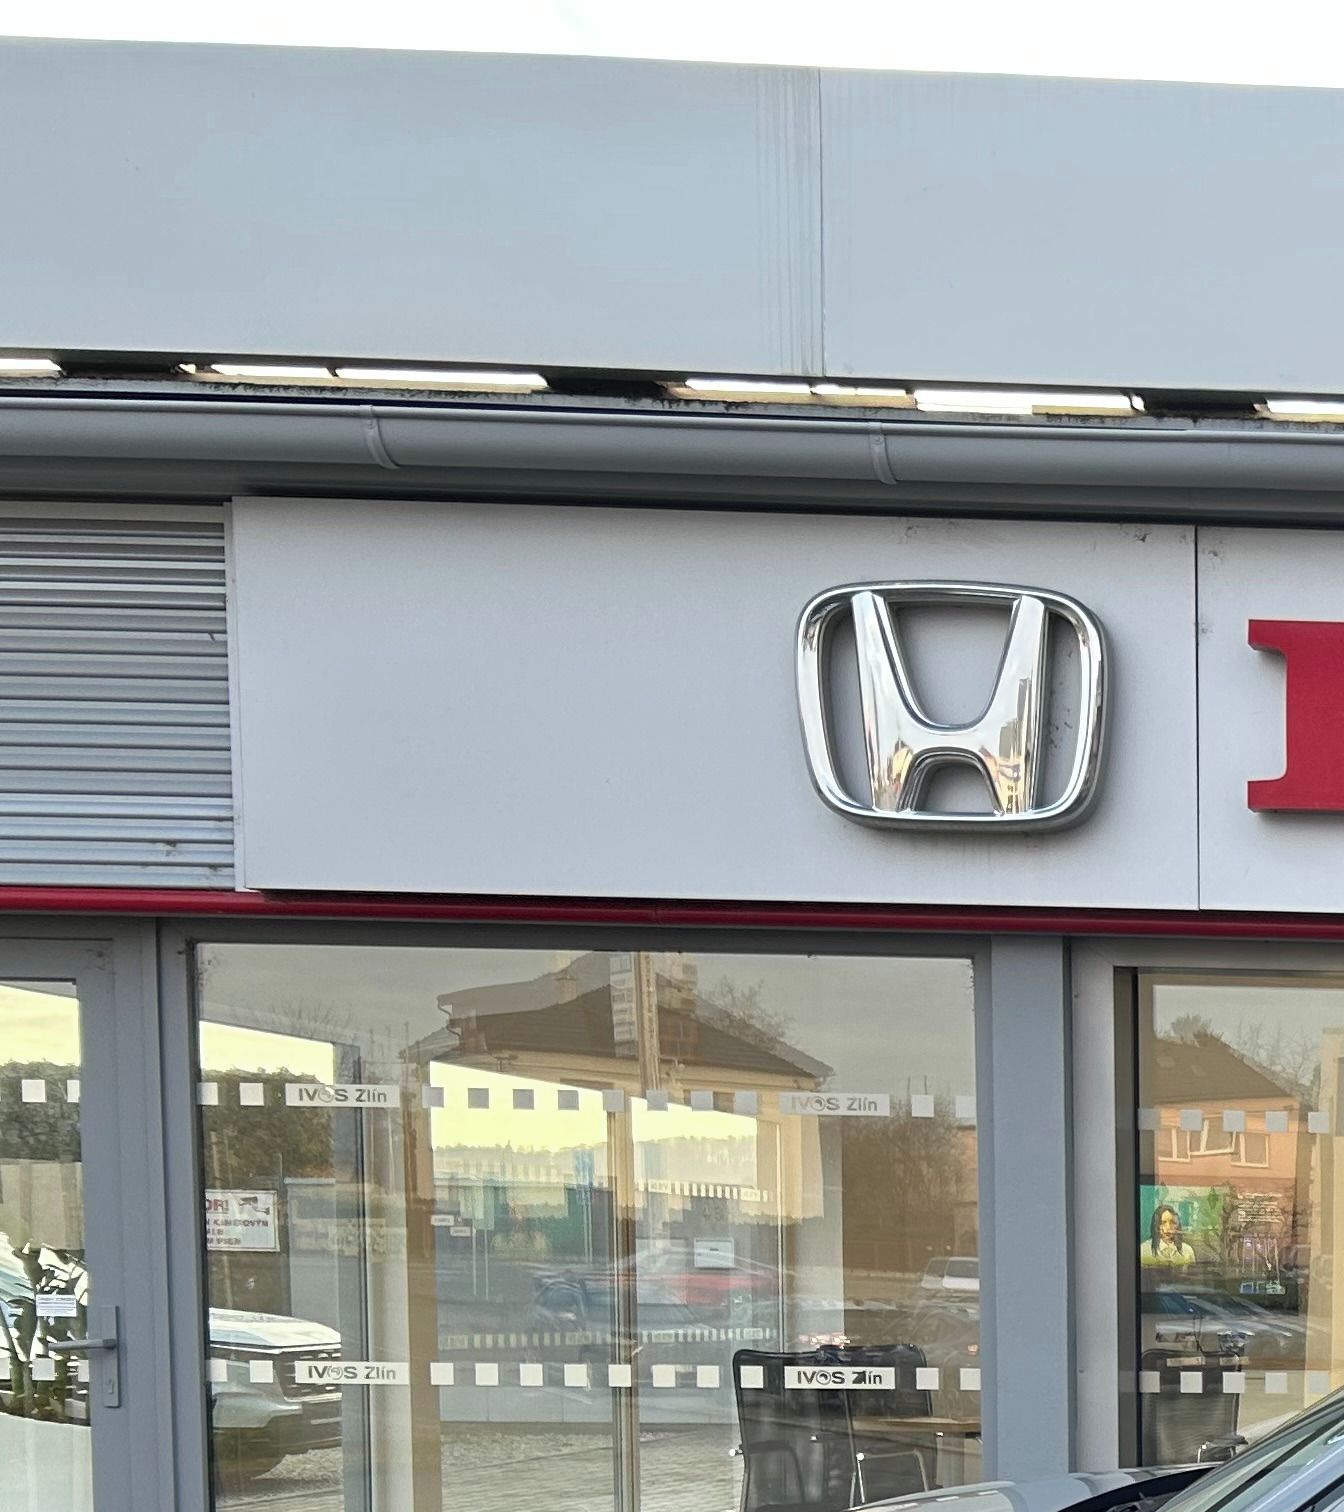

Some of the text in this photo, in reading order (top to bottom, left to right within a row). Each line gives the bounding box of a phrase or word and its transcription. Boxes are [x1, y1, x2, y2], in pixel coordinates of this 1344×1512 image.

[299, 1087, 387, 1103] IVOS Zlín
[846, 1097, 878, 1112] Zlín
[308, 1365, 396, 1380] IVOS Zlín
[797, 1370, 845, 1385] IVOS
